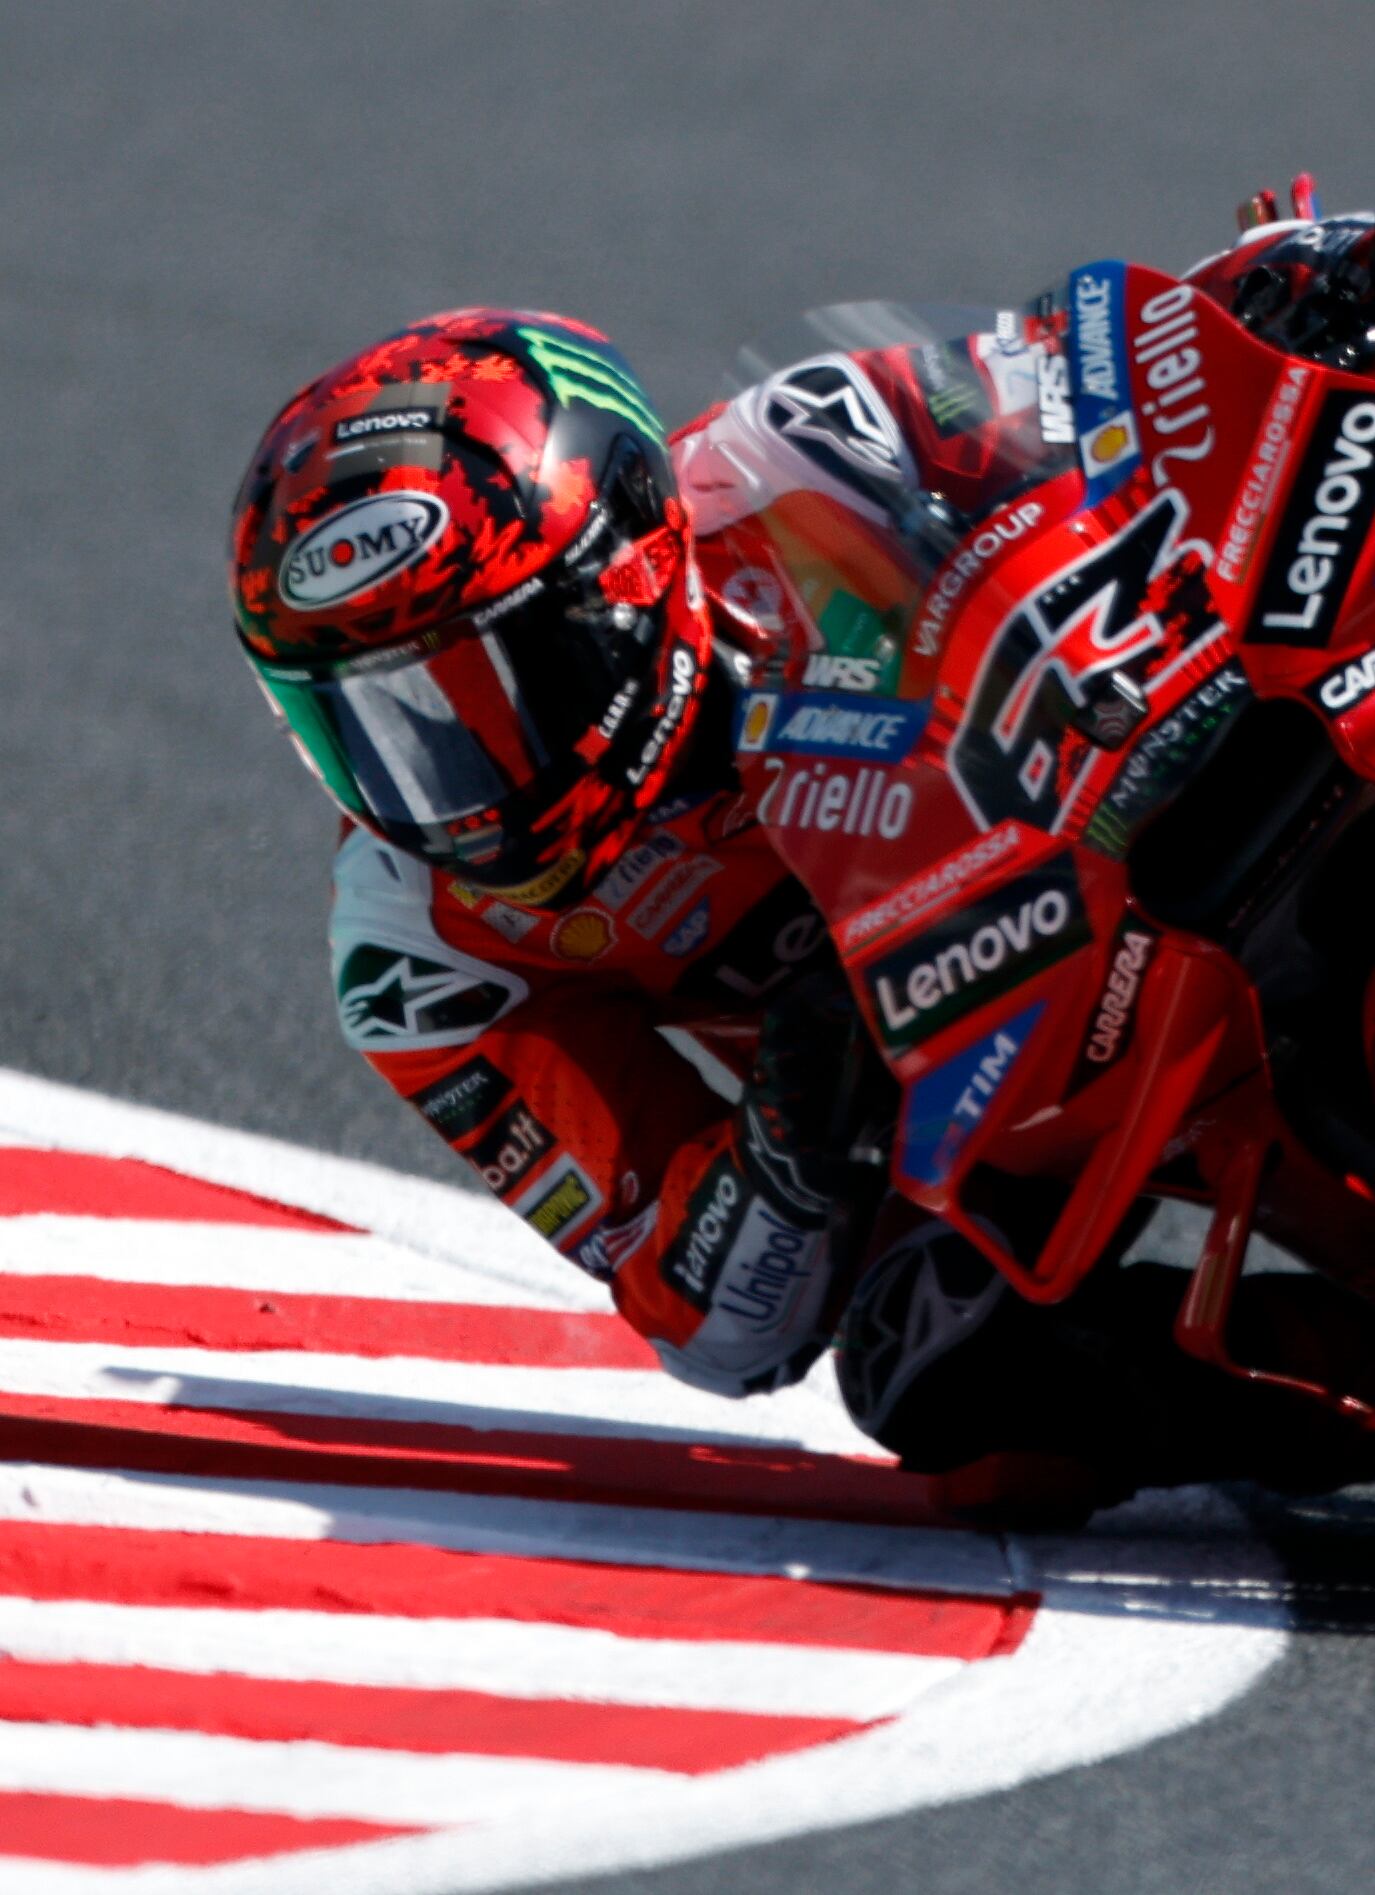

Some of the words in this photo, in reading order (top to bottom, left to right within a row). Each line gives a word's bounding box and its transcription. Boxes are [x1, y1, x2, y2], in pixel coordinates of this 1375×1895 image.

[1075, 273, 1118, 400] ADVANCE
[335, 409, 432, 440] Lenovo
[287, 514, 426, 586] SUOMY
[911, 501, 1045, 658] VARGROUP
[626, 648, 697, 785] Lenovo
[777, 707, 907, 750] ADVANCE
[802, 655, 882, 691] WRS
[1111, 670, 1247, 808] MONSTER
[876, 889, 1070, 1031] Lenovo
[1086, 930, 1153, 1063] CARRERA
[953, 1032, 1019, 1119] TIM
[673, 1174, 739, 1292] Lenovo
[719, 1208, 812, 1321] Unipol
